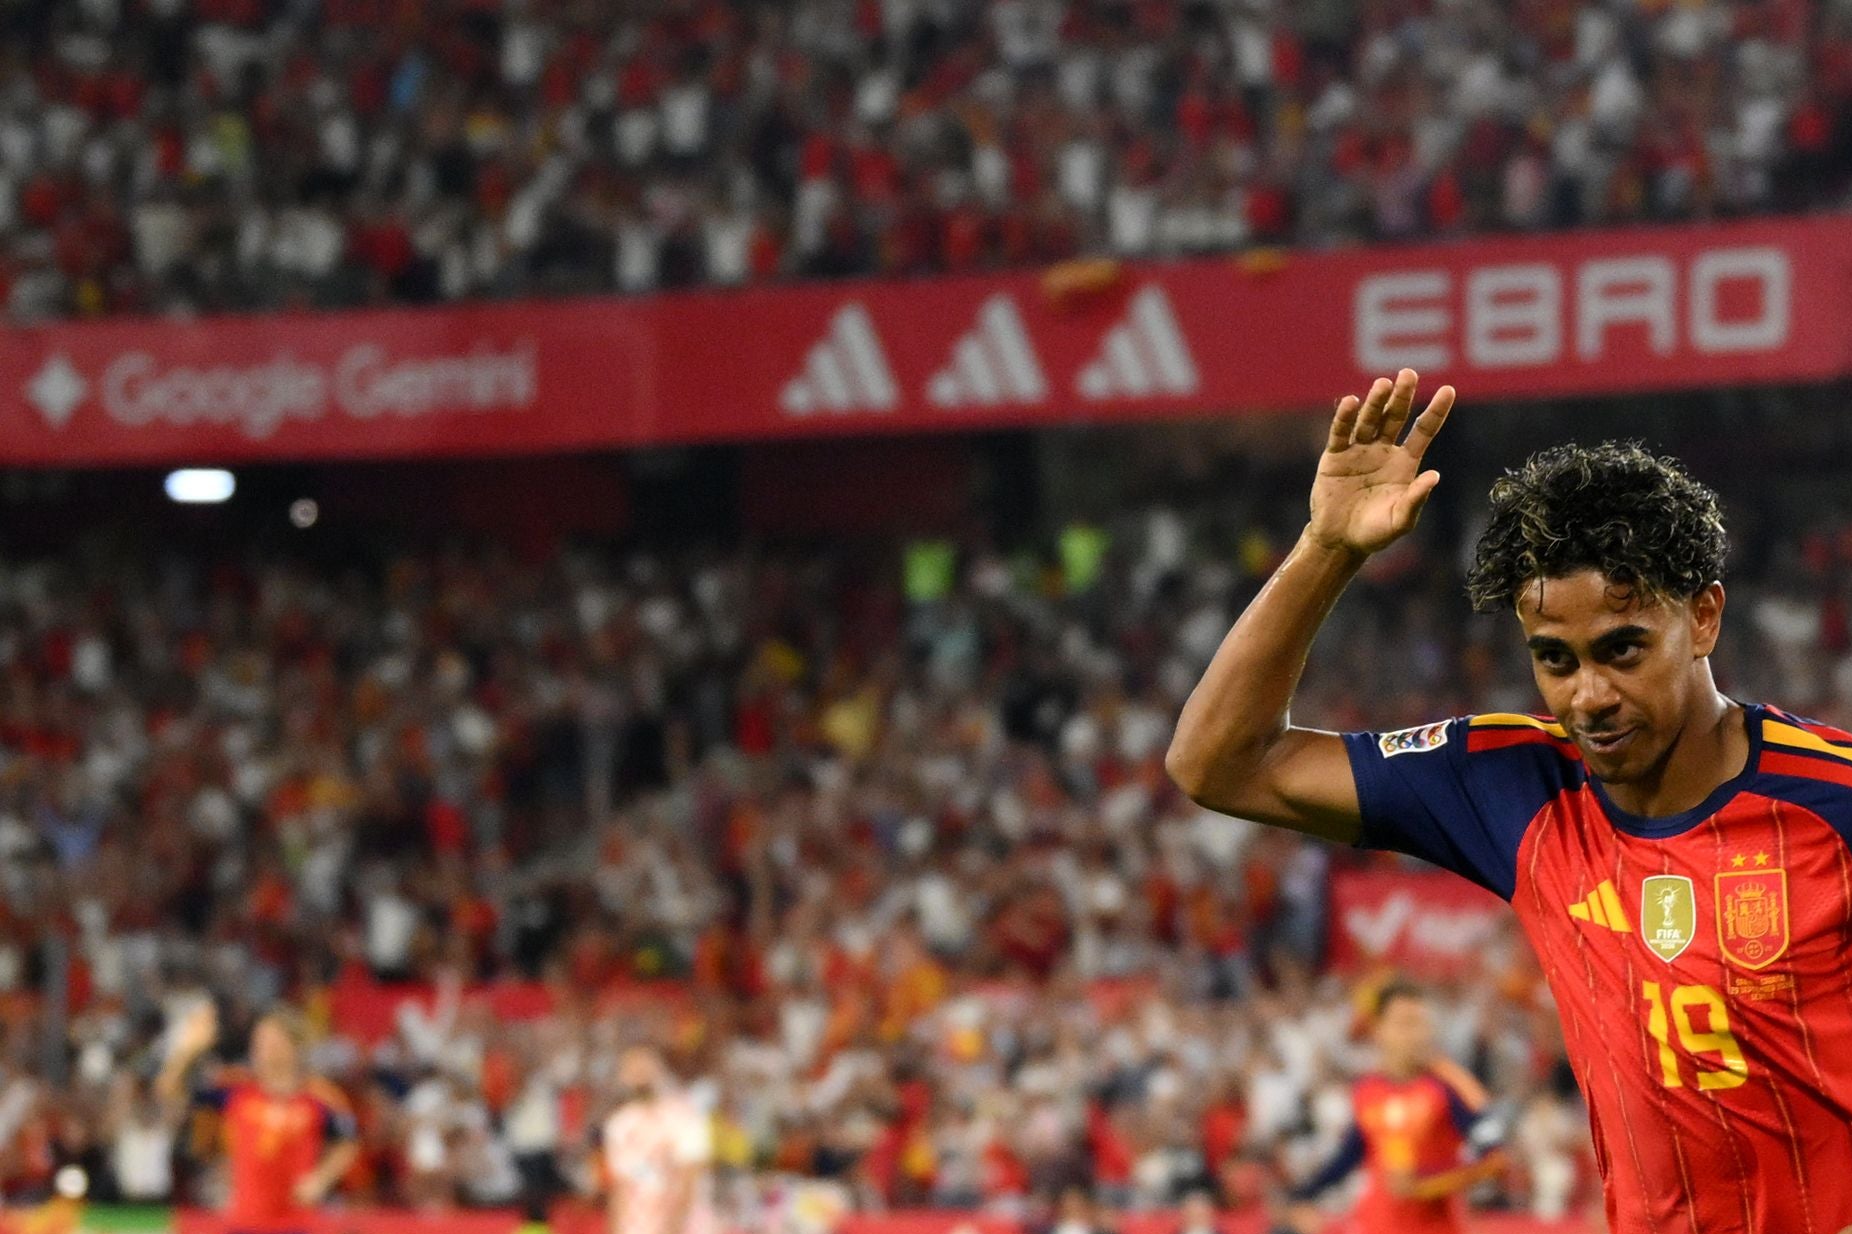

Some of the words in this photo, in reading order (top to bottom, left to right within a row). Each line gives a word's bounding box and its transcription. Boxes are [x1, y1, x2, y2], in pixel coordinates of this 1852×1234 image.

[1354, 247, 1792, 373] EBRO
[102, 351, 327, 440] Google
[1656, 929, 1681, 939] FIFA
[1642, 980, 1748, 1090] 19
